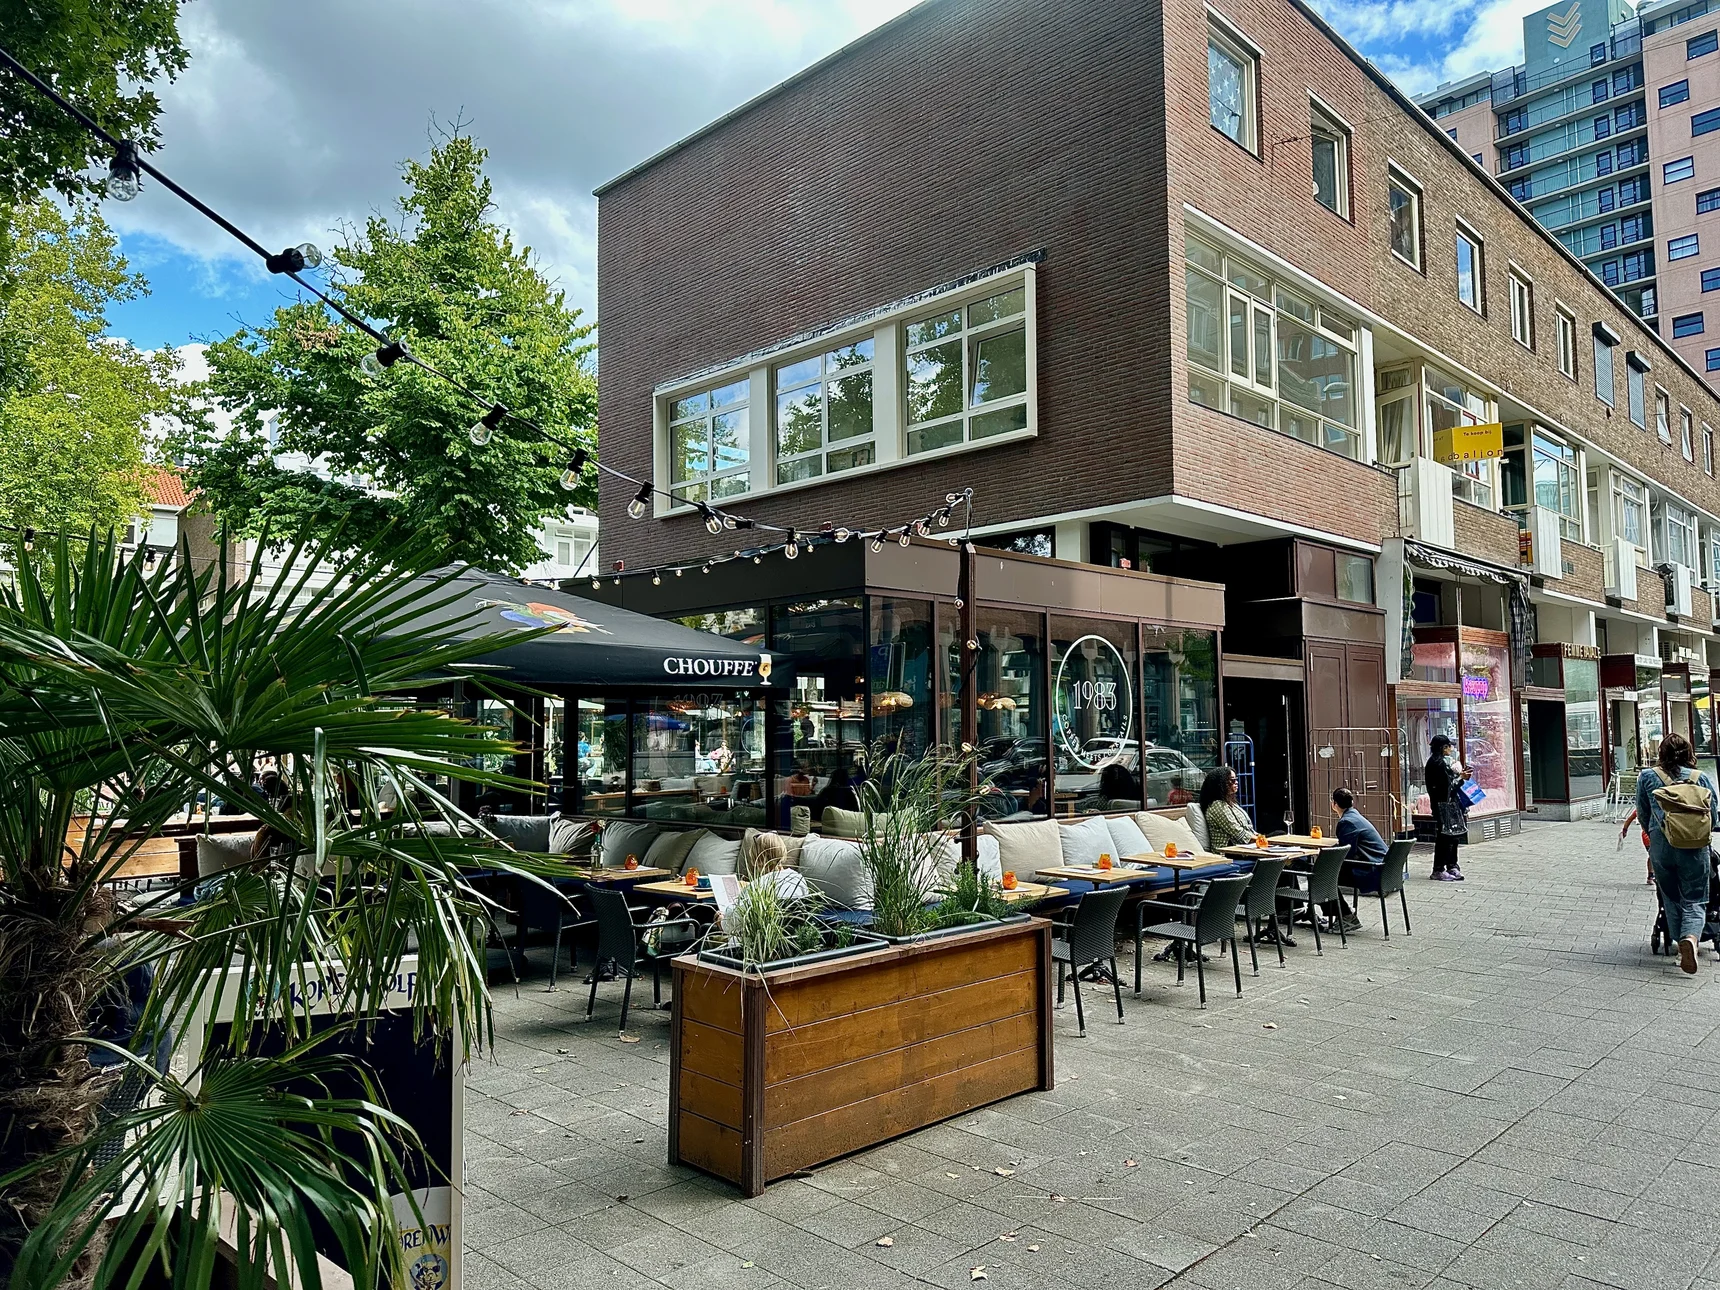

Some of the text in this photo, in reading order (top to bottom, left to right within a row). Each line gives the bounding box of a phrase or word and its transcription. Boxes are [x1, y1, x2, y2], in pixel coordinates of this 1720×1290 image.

[663, 657, 755, 677] CHOUFFE
[1073, 680, 1117, 710] 1983
[1081, 748, 1102, 761] MEETS
